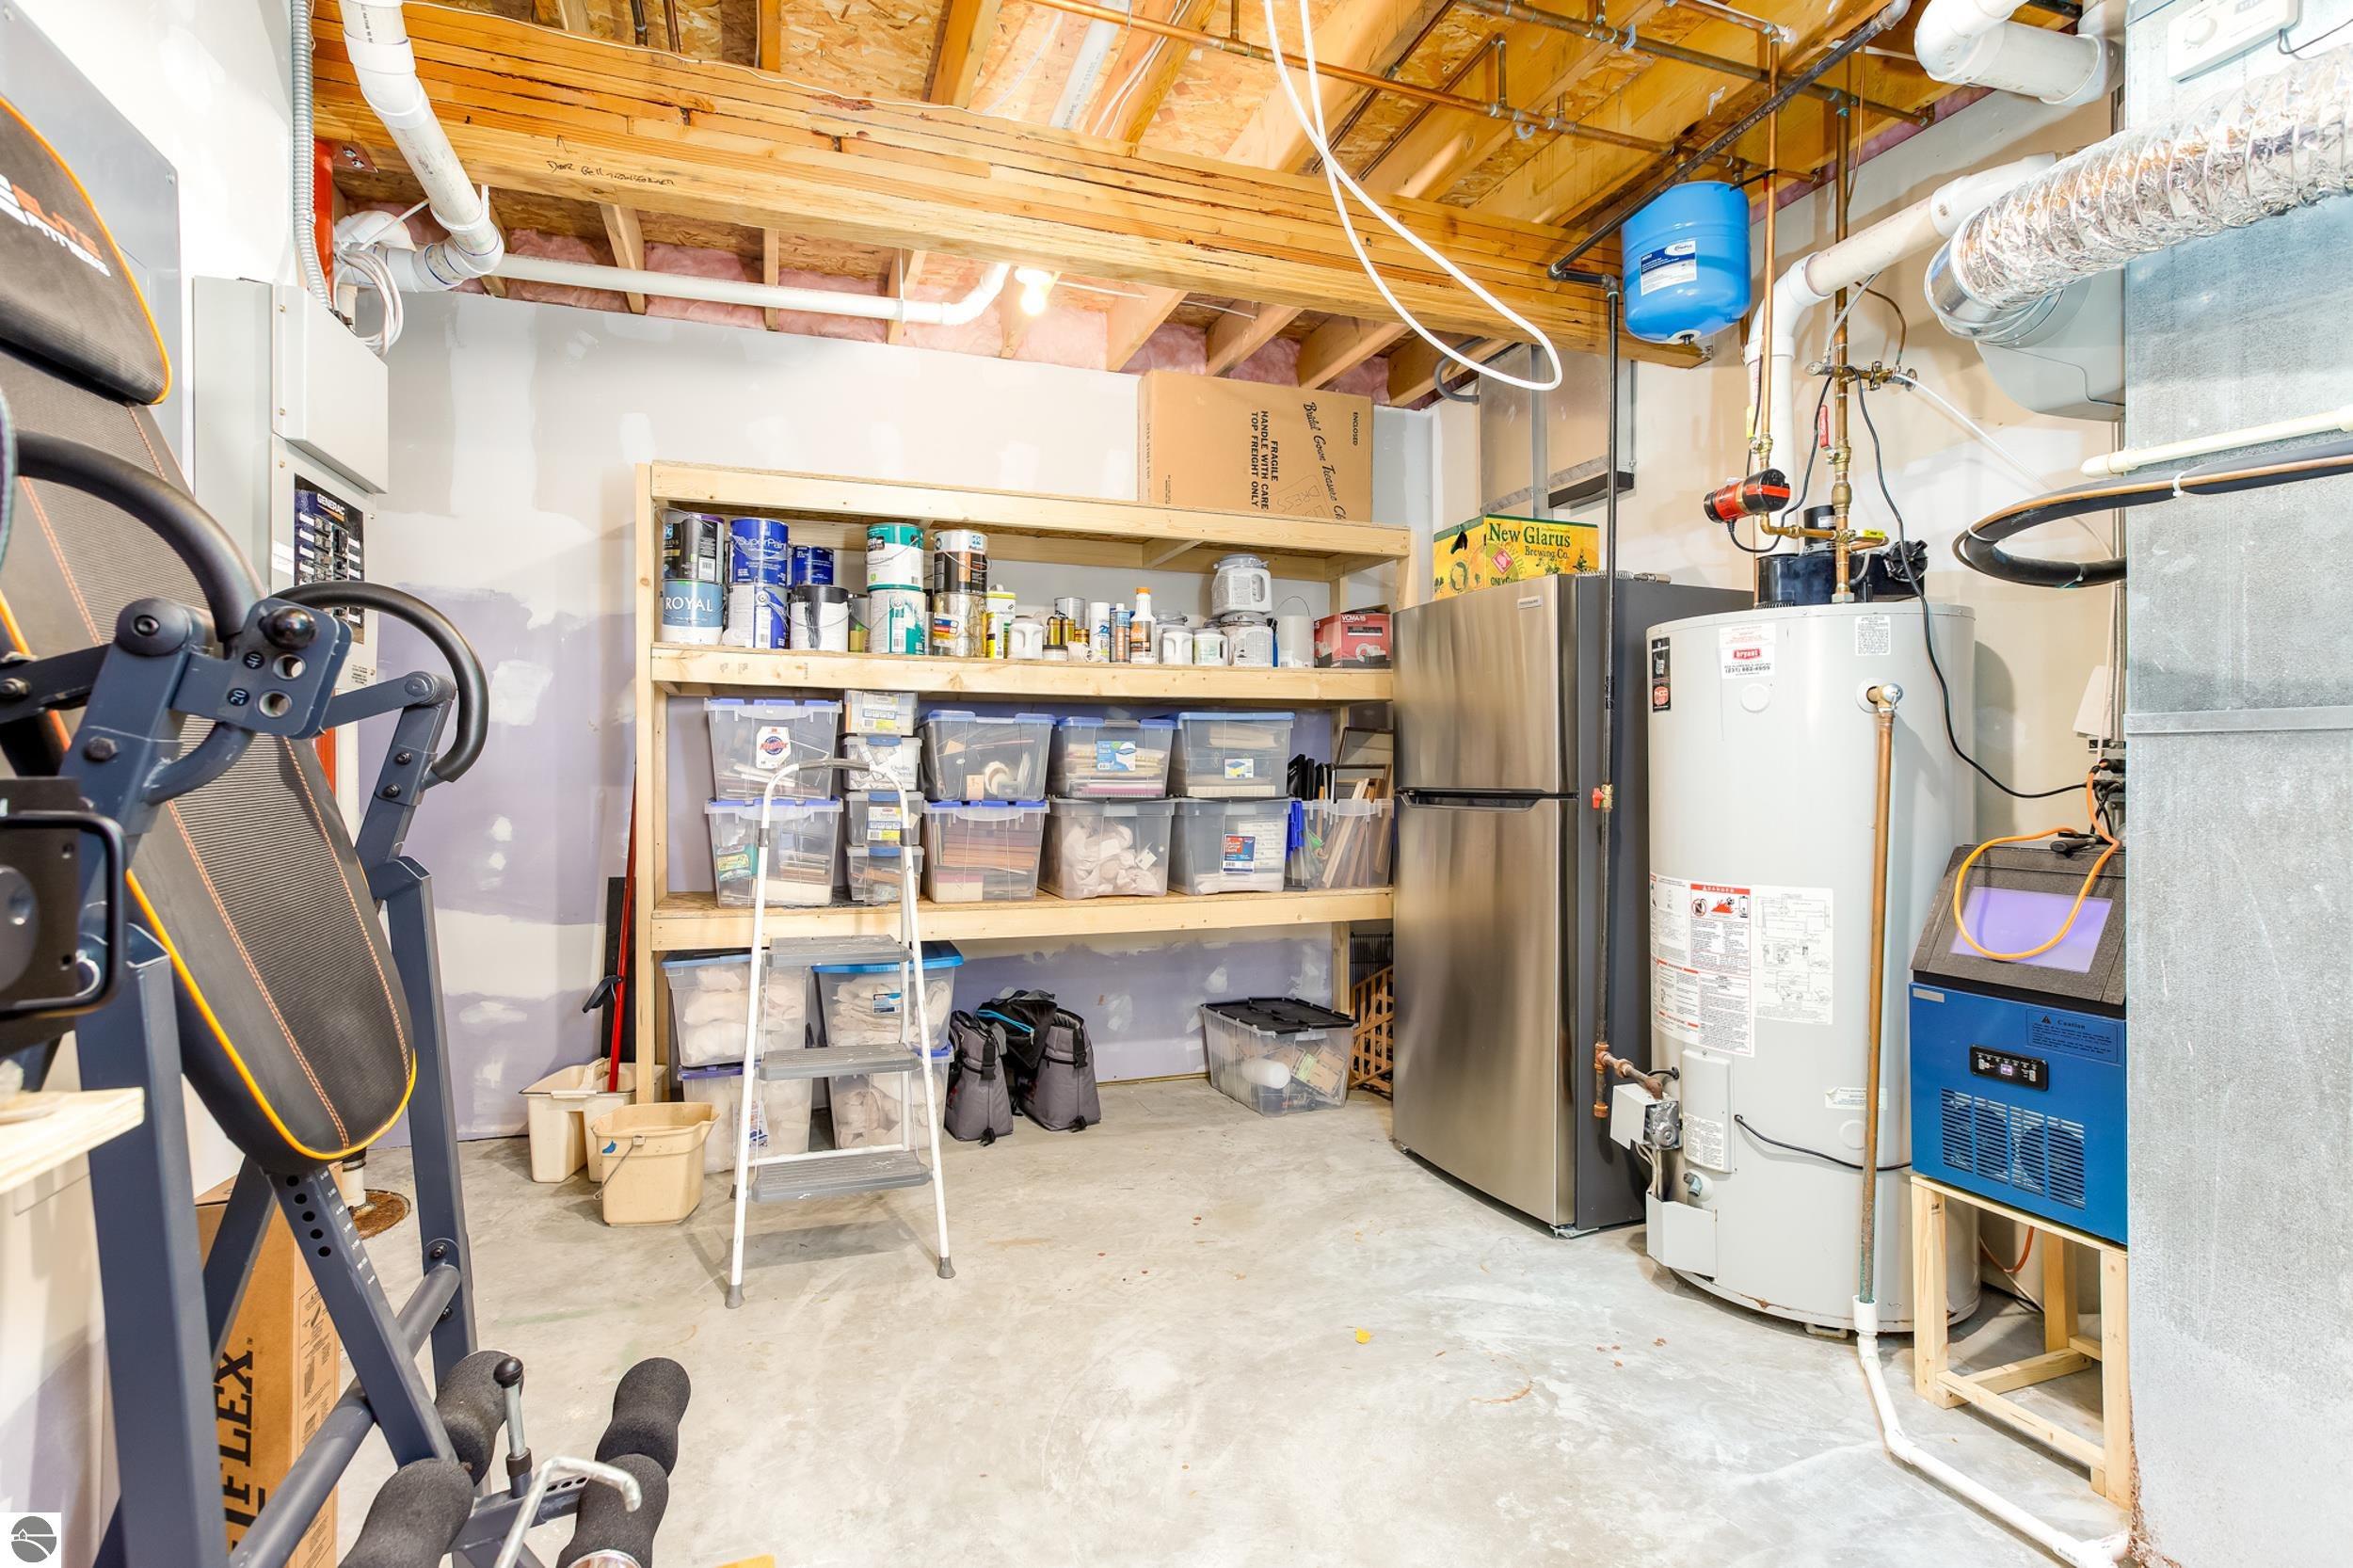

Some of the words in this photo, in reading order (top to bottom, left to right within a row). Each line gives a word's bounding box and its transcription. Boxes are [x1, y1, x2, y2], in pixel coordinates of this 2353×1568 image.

[1260, 410, 1269, 449] HANDLE
[1251, 435, 1259, 476] FREIGHT
[1260, 455, 1269, 480] WITH
[1271, 440, 1279, 482] FRAGILE
[1313, 435, 1326, 461] Gown
[1322, 465, 1337, 502] Treasure
[1333, 505, 1346, 520] Ch
[316, 493, 345, 516] GENERAC
[1260, 483, 1269, 510] CARE
[1488, 522, 1521, 543] New
[1523, 526, 1571, 549] Glarus
[1525, 545, 1556, 560] Brewing
[1557, 548, 1570, 559] Co.
[664, 596, 713, 613] ROYAL
